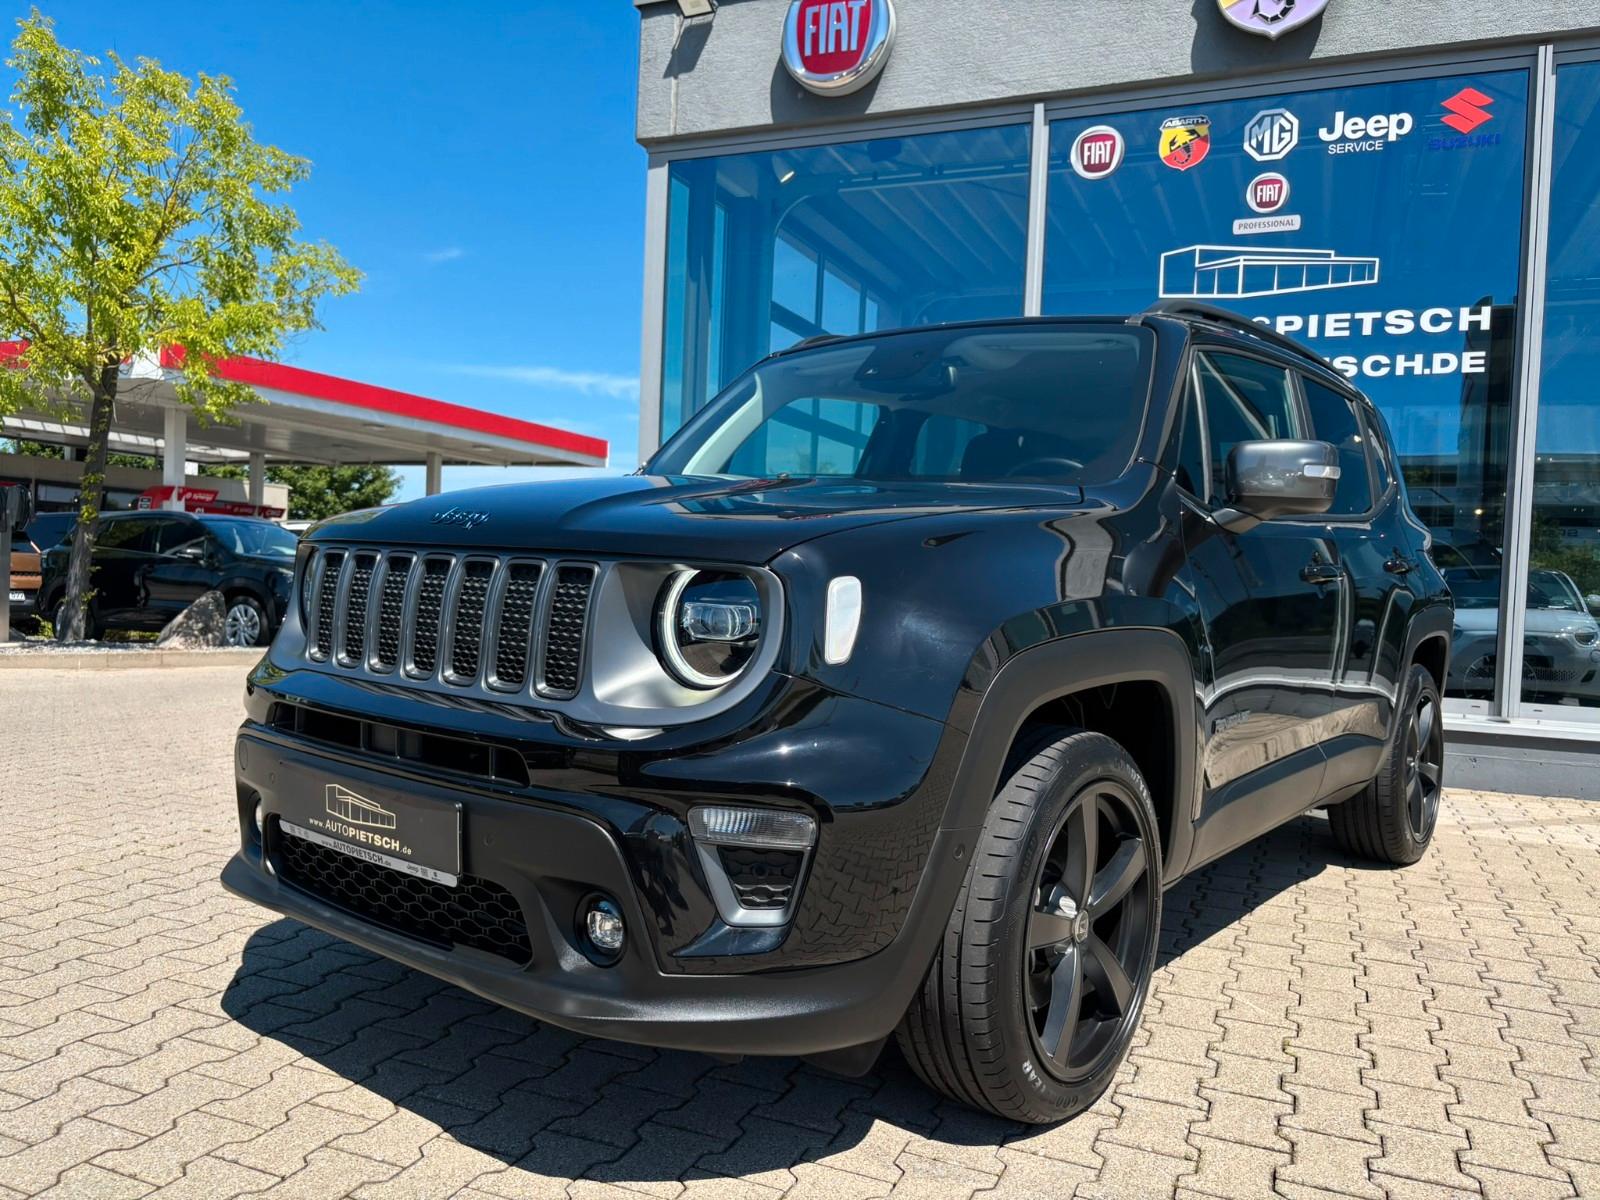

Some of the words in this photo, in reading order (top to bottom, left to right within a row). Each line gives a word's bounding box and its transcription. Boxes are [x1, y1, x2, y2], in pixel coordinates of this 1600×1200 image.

[804, 0, 867, 57] FIAT
[1164, 117, 1208, 128] ABARTH
[1250, 115, 1293, 154] MG
[1318, 111, 1413, 141] Jeep
[1083, 140, 1114, 165] FIAT
[1328, 140, 1384, 154] SERVICE
[1256, 183, 1281, 203] FIAT
[1238, 219, 1296, 231] PROFESSIONAL
[1325, 351, 1487, 378] SCH.DE
